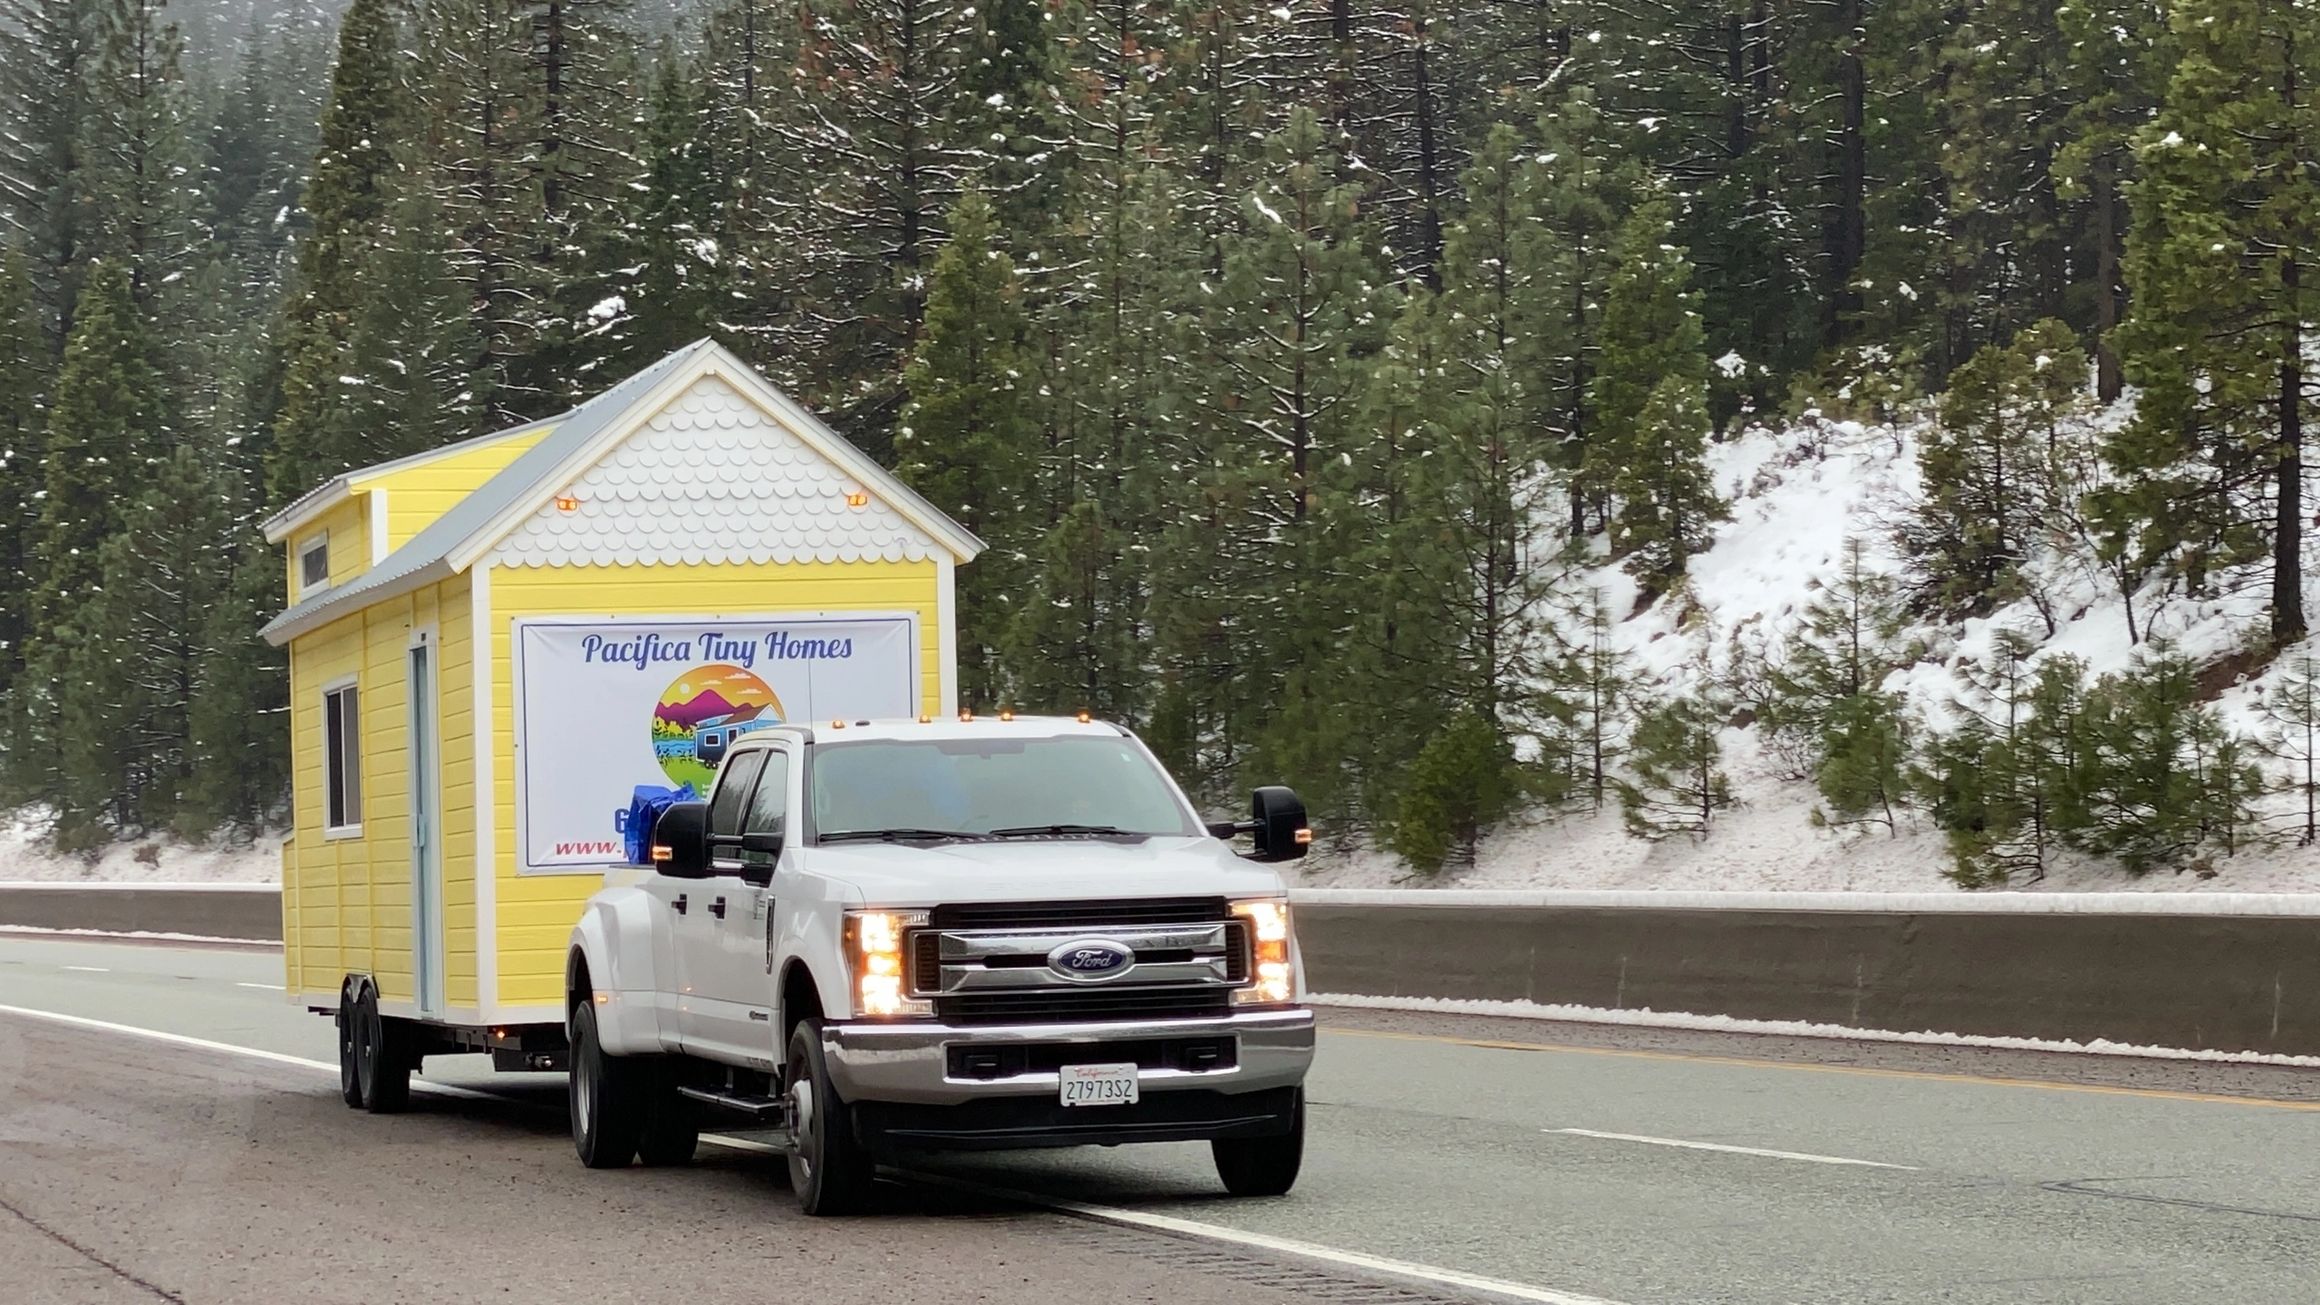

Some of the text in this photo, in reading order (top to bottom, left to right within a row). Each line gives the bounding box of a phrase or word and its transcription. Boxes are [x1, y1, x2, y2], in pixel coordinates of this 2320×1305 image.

[582, 631, 852, 671] Pacifica Tiny Homes
[1072, 949, 1113, 968] Ford
[1066, 1079, 1132, 1100] 27973S2
